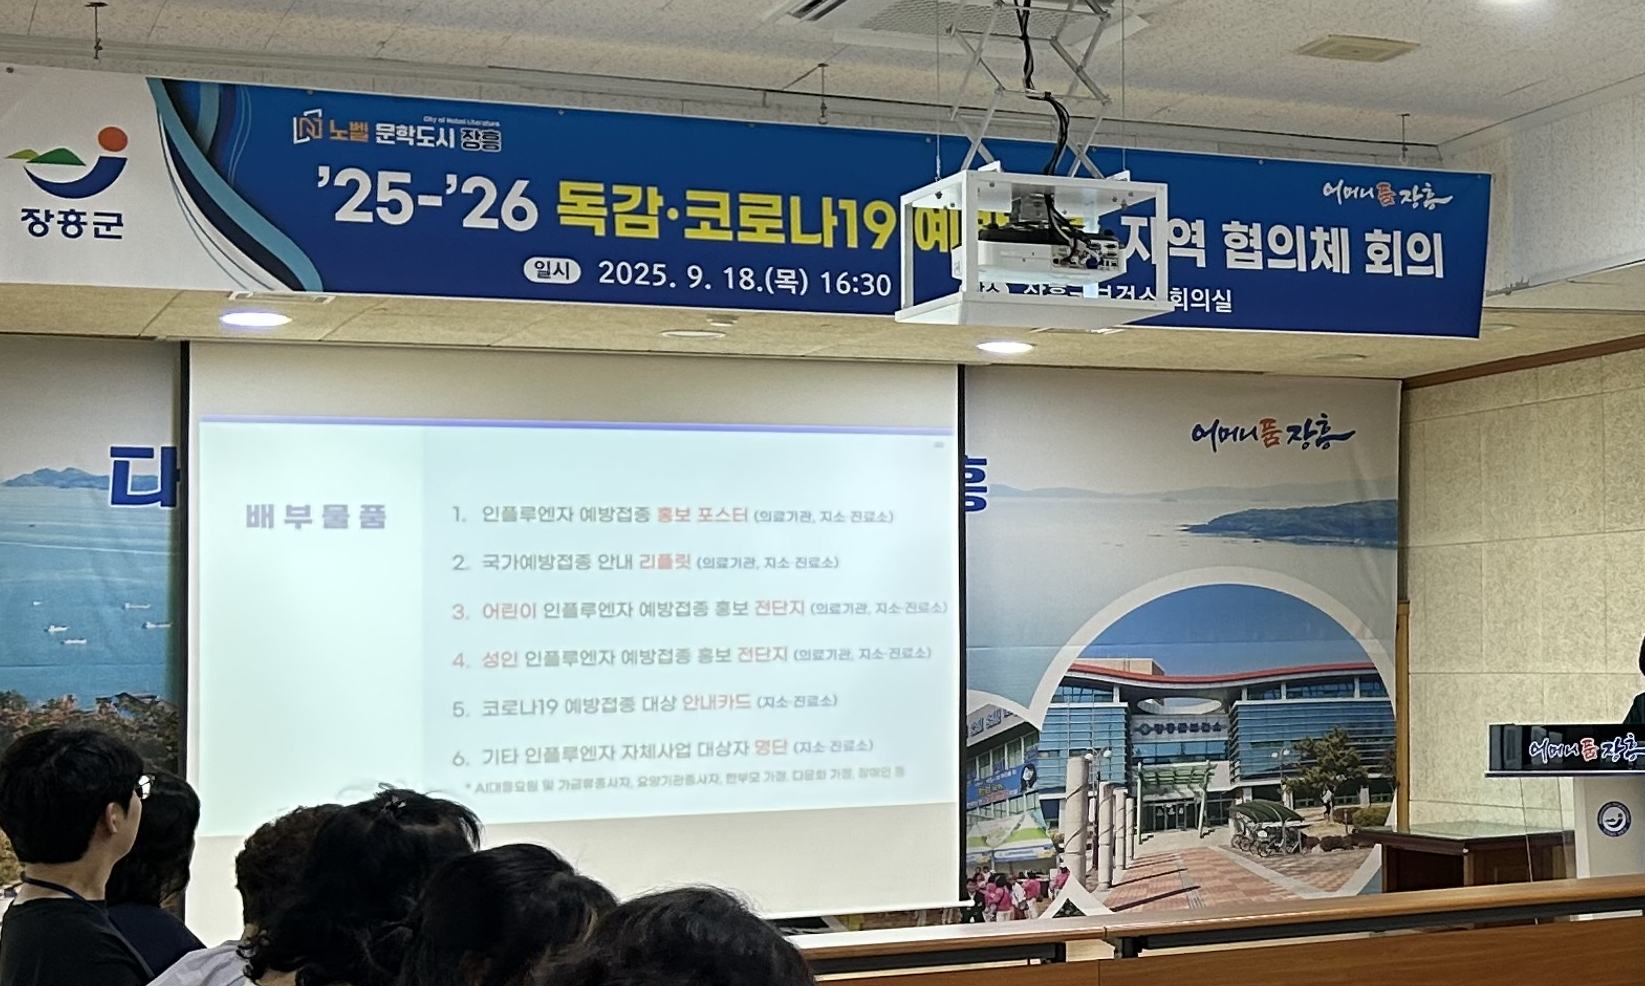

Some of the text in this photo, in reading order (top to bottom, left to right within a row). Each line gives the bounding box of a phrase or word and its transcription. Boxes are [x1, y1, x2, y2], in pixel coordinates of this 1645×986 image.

[329, 119, 502, 152] 노벨 문학도시 장흥
[1399, 182, 1453, 210] 장흥
[21, 208, 123, 239] 장흥군
[1120, 216, 1206, 268] 지역
[1222, 220, 1350, 275] 협의체
[1365, 229, 1444, 279] 회의
[534, 260, 570, 281] 일시
[598, 261, 676, 288] 2025.
[687, 264, 711, 290] 9.
[821, 272, 891, 297] 16:30
[1169, 286, 1233, 313] 회의실
[1286, 412, 1356, 450] 장흥
[482, 505, 574, 524] 인플루엔자
[580, 505, 650, 524] 예방접종
[657, 505, 690, 523] 홍보
[697, 506, 749, 523] 포스터
[482, 553, 592, 571] 국가예방접종
[598, 553, 633, 571] 안내
[639, 553, 692, 571] 리플릿
[482, 602, 537, 620] 어린이
[543, 600, 633, 619] 인플루엔자
[639, 600, 709, 618] 예방접종
[715, 600, 749, 617] 홍보
[755, 599, 805, 617] 전단지
[481, 650, 519, 669] 성인
[525, 648, 616, 667] 인플루엔자
[621, 647, 691, 666] 예방접종
[697, 647, 731, 664] 홍보
[737, 646, 788, 663] 전단지
[482, 698, 559, 717] 코로나19
[565, 696, 636, 714] 예방접종
[641, 695, 677, 713] 대상
[683, 693, 752, 711] 안내카드
[482, 748, 519, 765] 기타
[525, 745, 616, 764] 인플루엔자
[621, 742, 692, 761] 자체사업
[697, 741, 750, 758] 대상자
[754, 739, 788, 756] 명단
